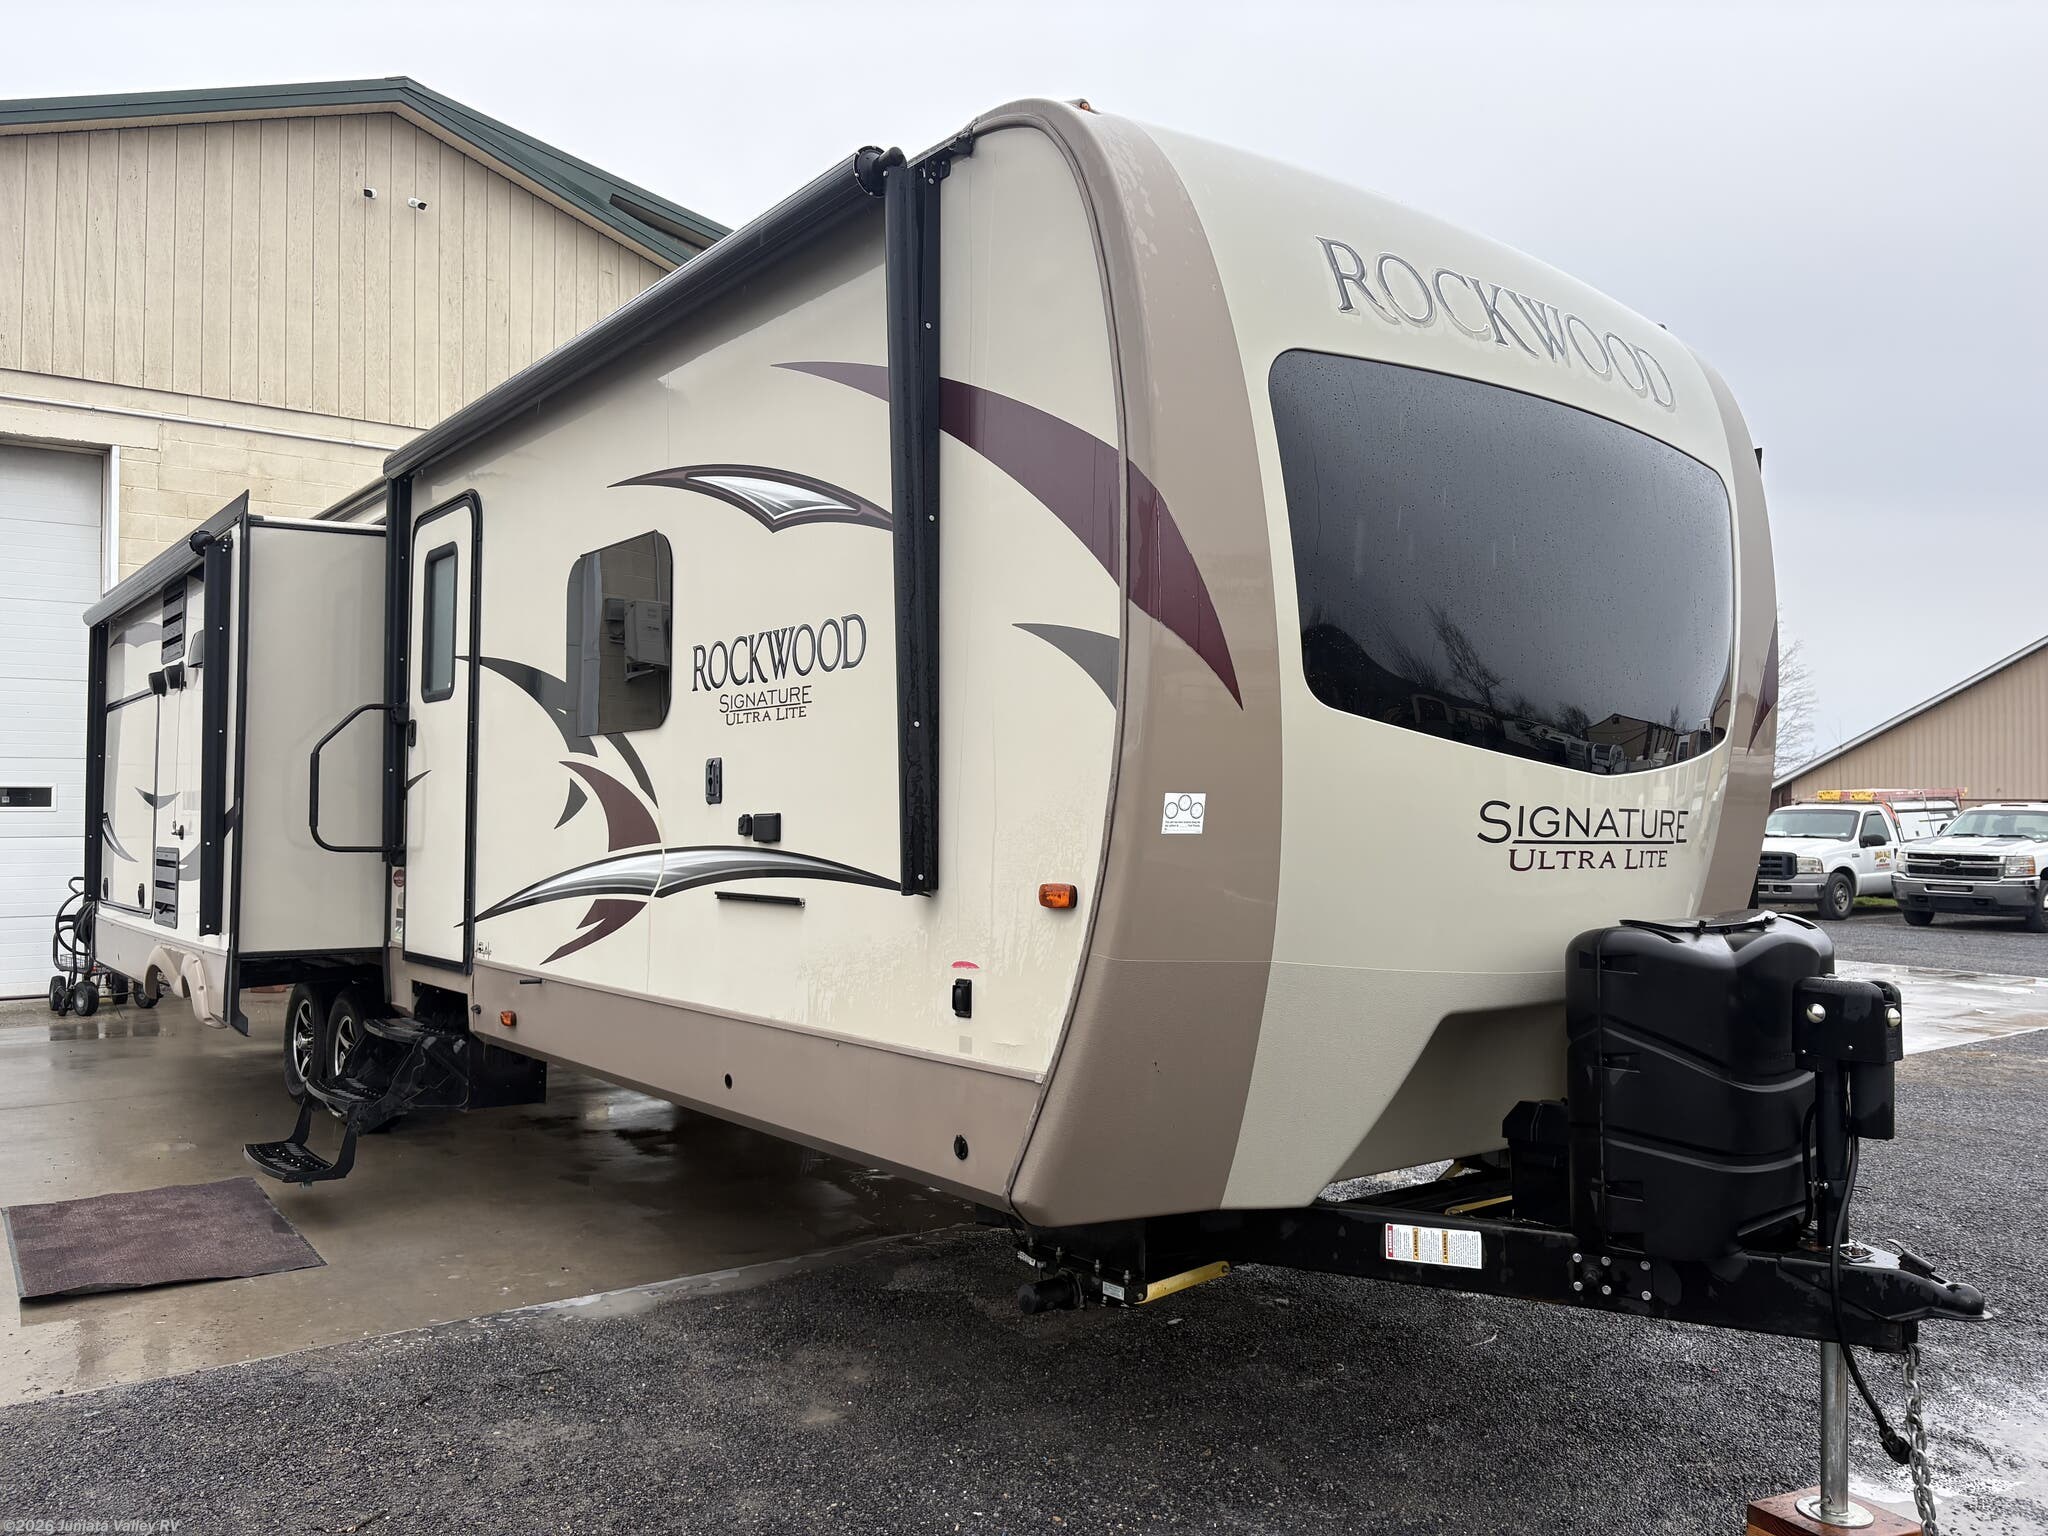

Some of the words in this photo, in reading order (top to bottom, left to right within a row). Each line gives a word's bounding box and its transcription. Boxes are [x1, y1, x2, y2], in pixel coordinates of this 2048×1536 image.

[1314, 234, 1674, 408] ROCKWOOD
[691, 613, 867, 692] ROCKWOOD
[719, 685, 812, 713] SIGNATURE
[725, 710, 772, 726] ULTRA
[775, 706, 807, 721] LITE
[1477, 800, 1689, 844] SIGNATURE
[1508, 848, 1617, 872] ULTRA
[1623, 848, 1668, 870] LITE
